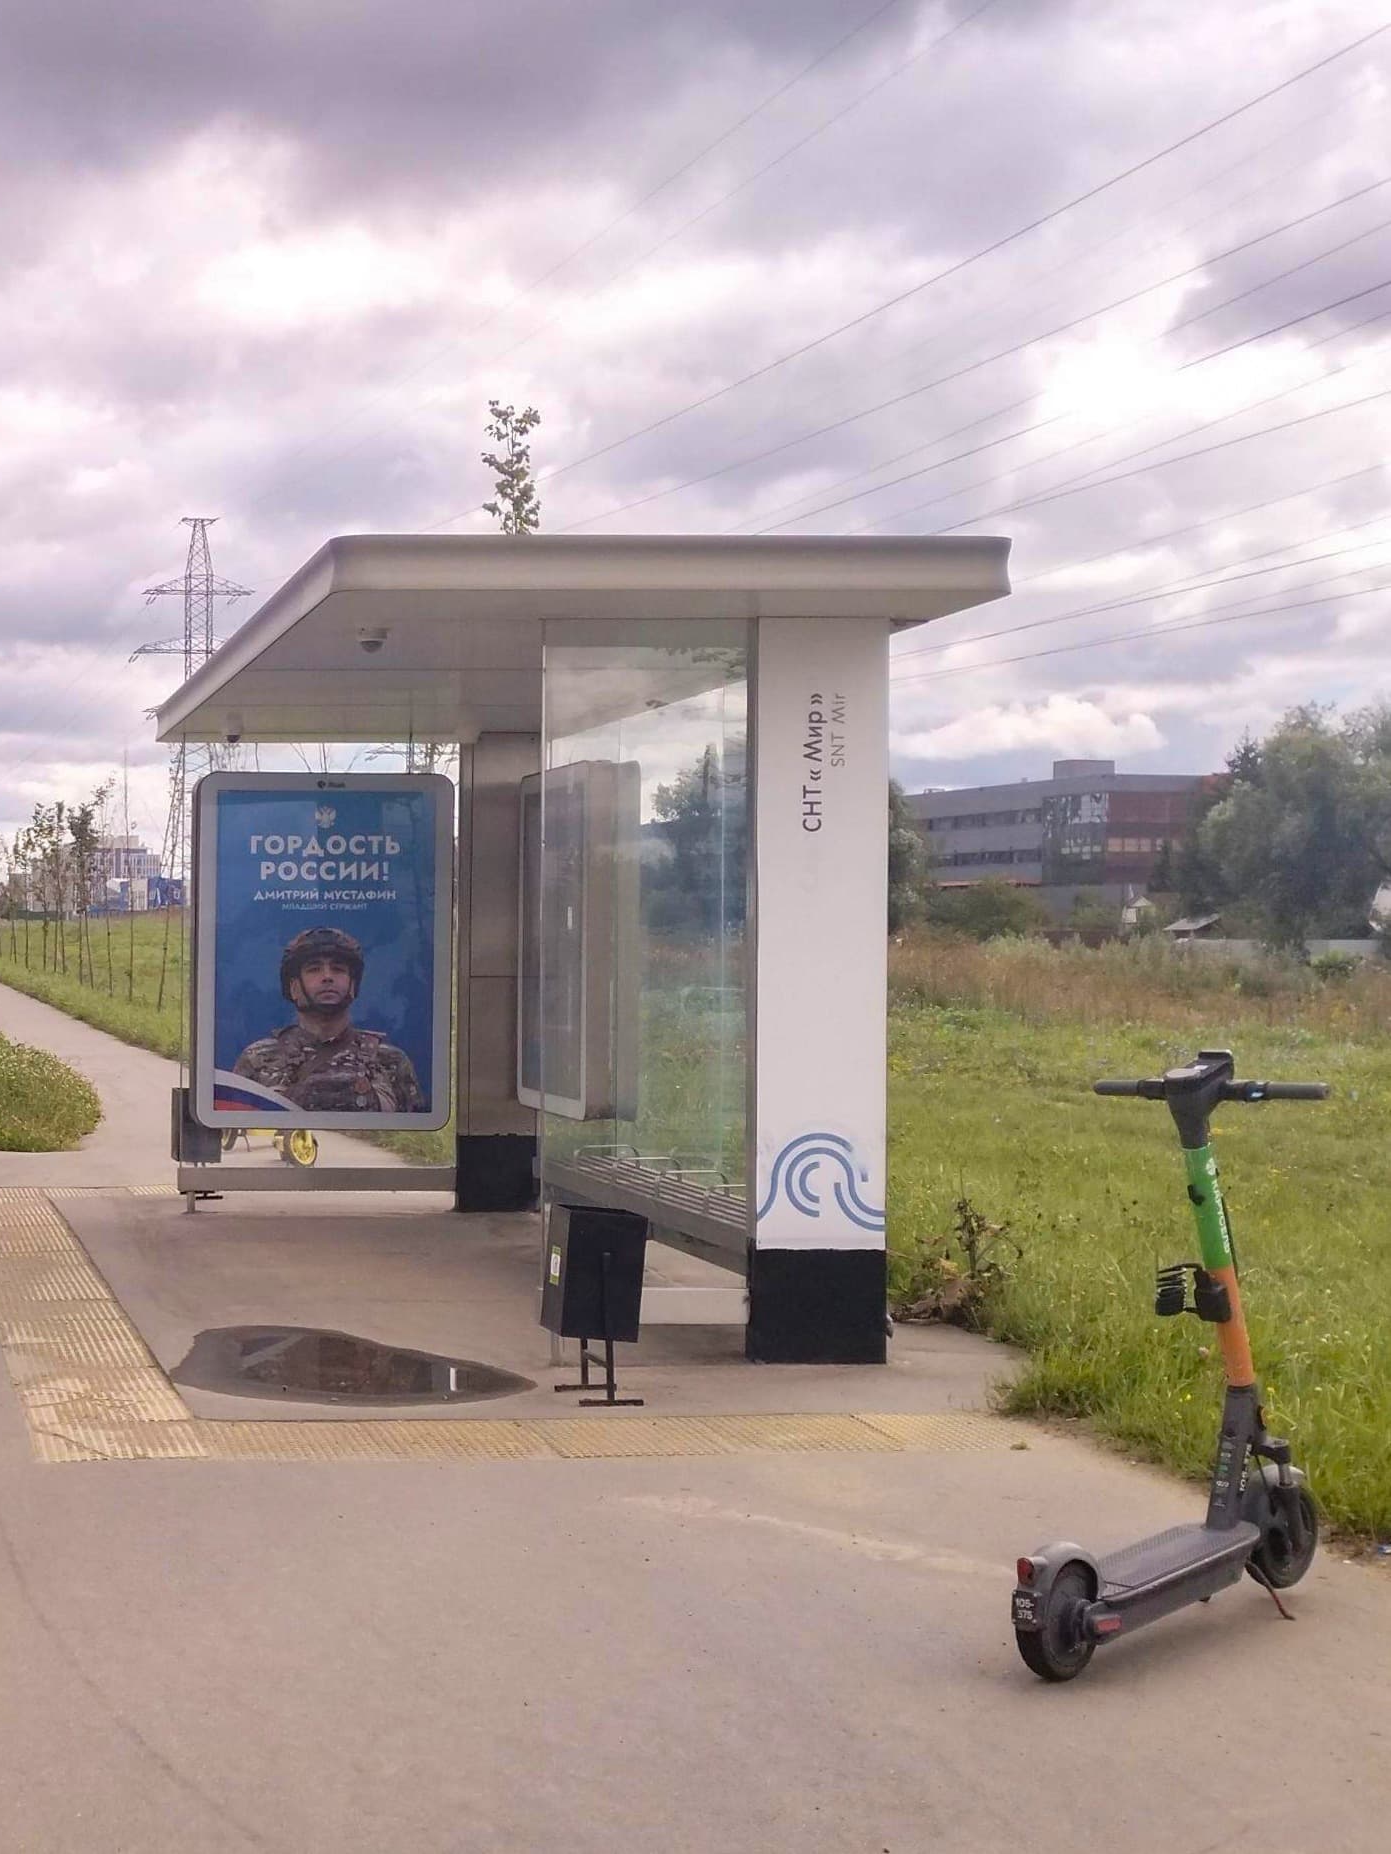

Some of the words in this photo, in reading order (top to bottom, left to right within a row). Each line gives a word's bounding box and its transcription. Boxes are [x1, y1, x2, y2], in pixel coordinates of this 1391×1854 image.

[831, 693, 846, 724] Mir
[830, 731, 846, 767] SNT
[802, 785, 822, 832] СНТ
[250, 834, 401, 857] ГОРДОСТЬ
[260, 861, 389, 881] РОССИИ!
[253, 888, 319, 901] ДМИТРИЙ
[324, 890, 396, 900] МУСТАФИН
